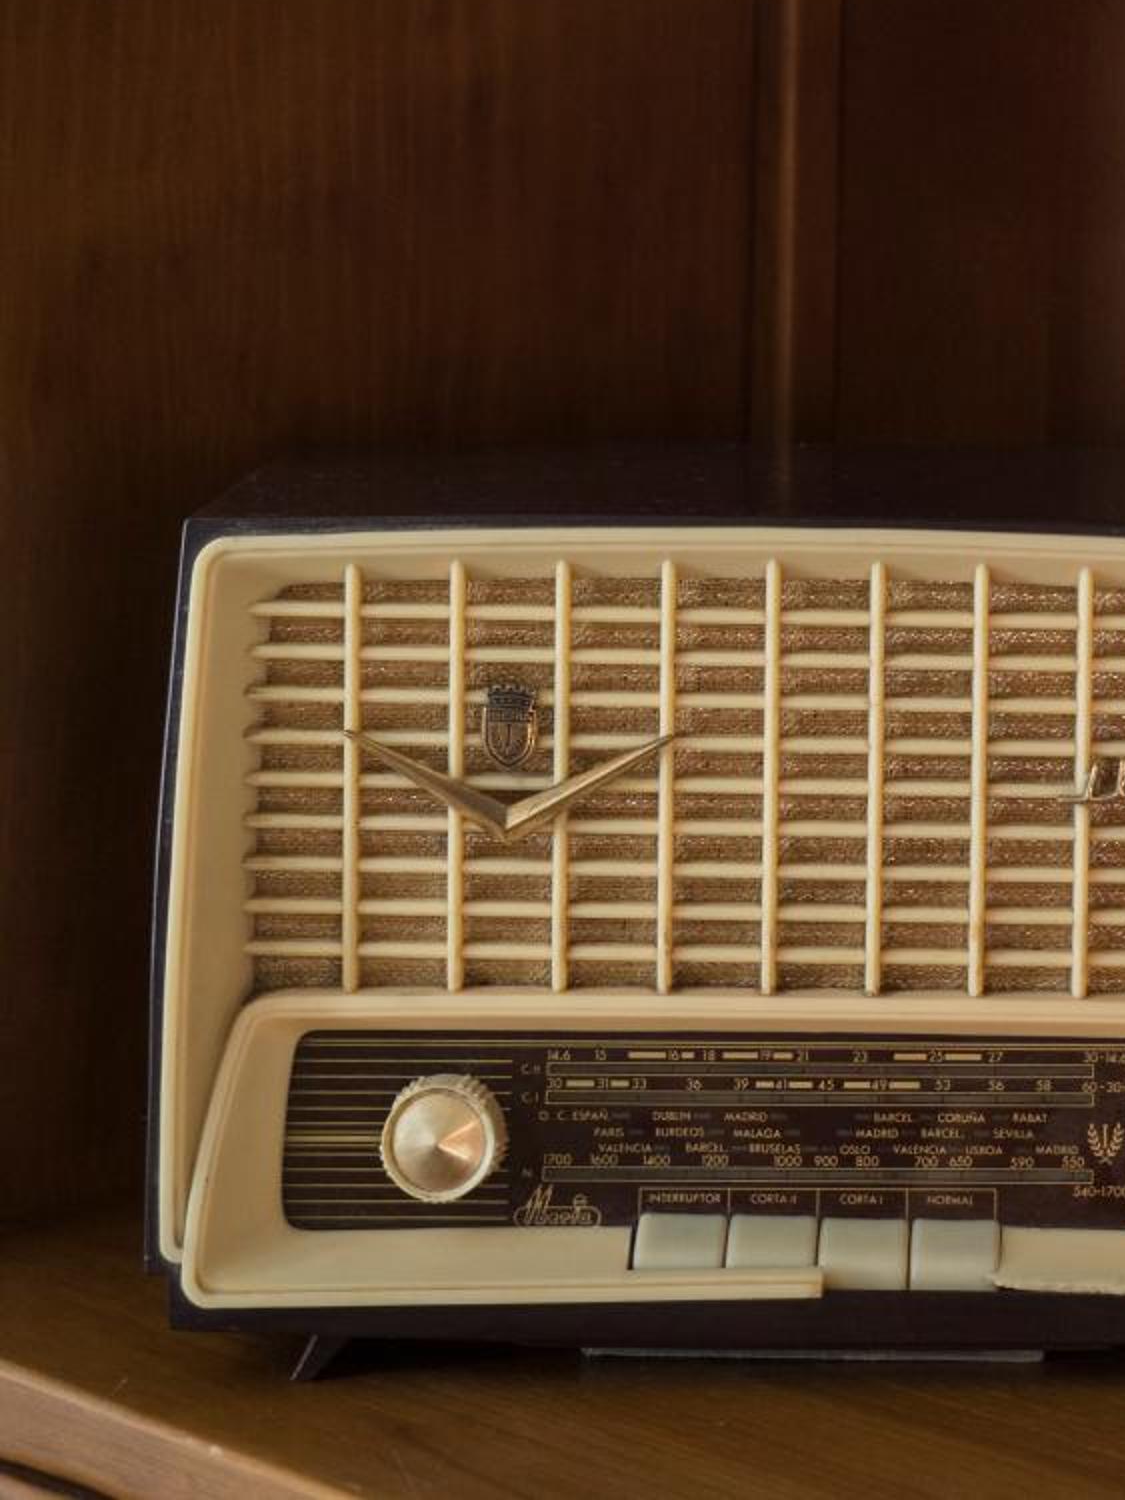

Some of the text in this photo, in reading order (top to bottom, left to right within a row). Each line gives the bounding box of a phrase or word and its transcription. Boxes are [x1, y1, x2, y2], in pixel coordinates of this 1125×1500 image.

[724, 1112, 768, 1122] MADRID
[937, 1111, 986, 1123] CORUÑA
[855, 1129, 899, 1139] MADRID
[992, 1129, 1034, 1139] SEVILLA
[599, 1142, 652, 1153] VALENCIA
[749, 1143, 801, 1154] BRUSELAS
[839, 1144, 871, 1154] OSLO
[893, 1144, 947, 1155] VALENCIA
[966, 1145, 1003, 1155] LISBOA
[1036, 1145, 1079, 1155] MADRID
[814, 1155, 838, 1167] 900
[915, 1156, 938, 1168] 700
[649, 1193, 722, 1204] INTERRUPTOR
